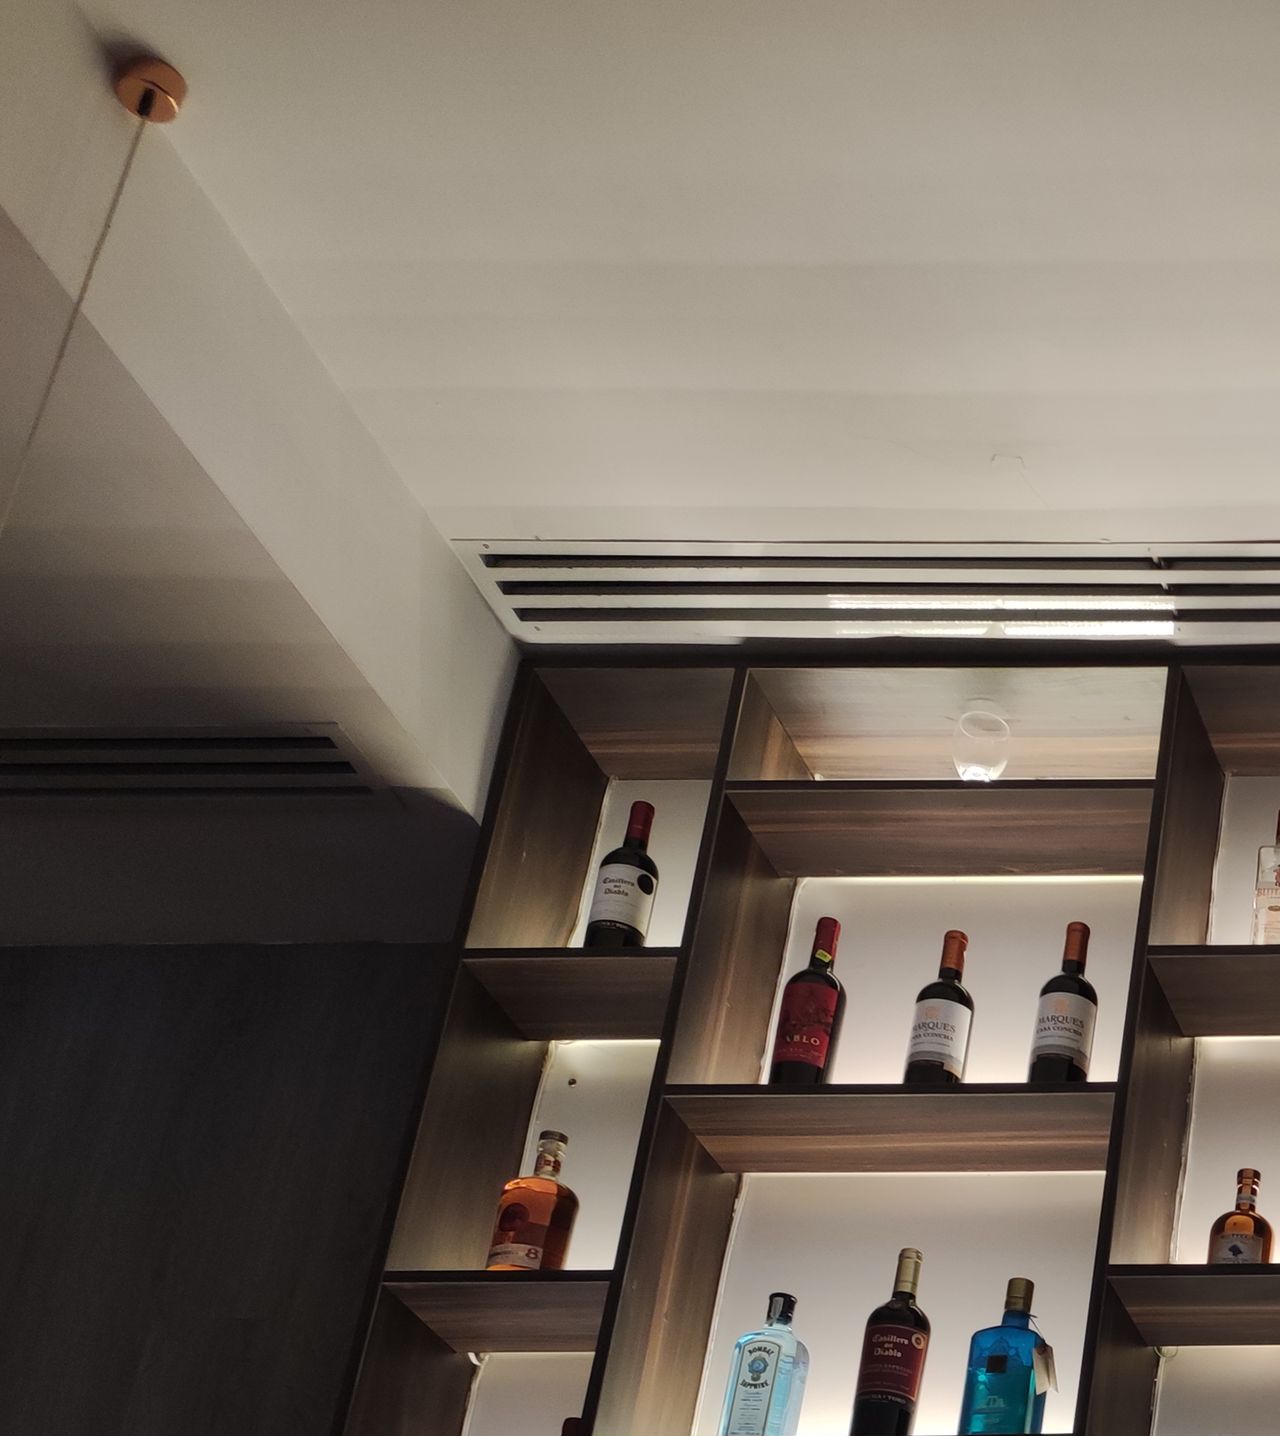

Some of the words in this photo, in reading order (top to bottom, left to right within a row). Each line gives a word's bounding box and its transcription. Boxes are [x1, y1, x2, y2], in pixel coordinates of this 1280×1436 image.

[525, 1248, 539, 1260] 8
[872, 1334, 910, 1346] Casillero
[873, 1347, 903, 1358] Diablo
